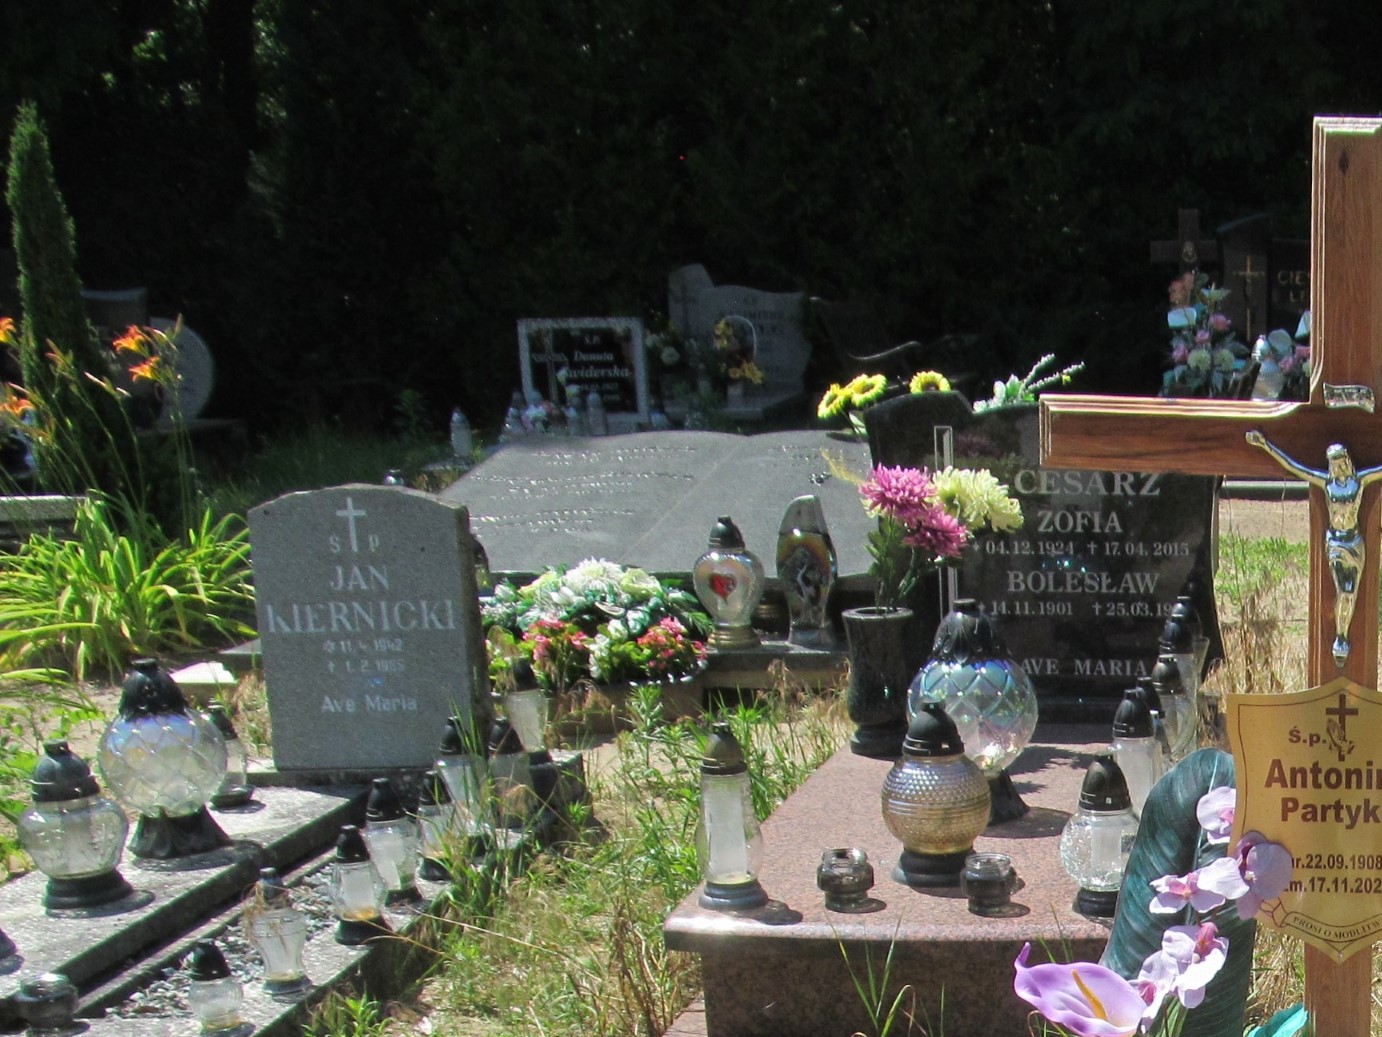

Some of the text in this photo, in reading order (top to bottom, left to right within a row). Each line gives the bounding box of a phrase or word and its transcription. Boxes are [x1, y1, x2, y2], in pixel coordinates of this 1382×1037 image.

[574, 350, 615, 362] Danuta
[1014, 470, 1161, 497] CESARZ
[1037, 510, 1124, 533] ZOFIA
[985, 540, 1075, 555] 04.12.1924
[329, 565, 390, 592] JAN
[1007, 570, 1160, 594] BOLESŁAW
[264, 600, 457, 634] KIERNICKI
[990, 602, 1073, 615] 14.11.1901
[1106, 602, 1173, 617] 25.03.19
[1020, 658, 1059, 674] AVE
[1073, 659, 1147, 676] MARIA
[320, 693, 418, 714] Ave Maria
[1288, 725, 1327, 746] Ś.p.
[1292, 915, 1323, 934] PROSI
